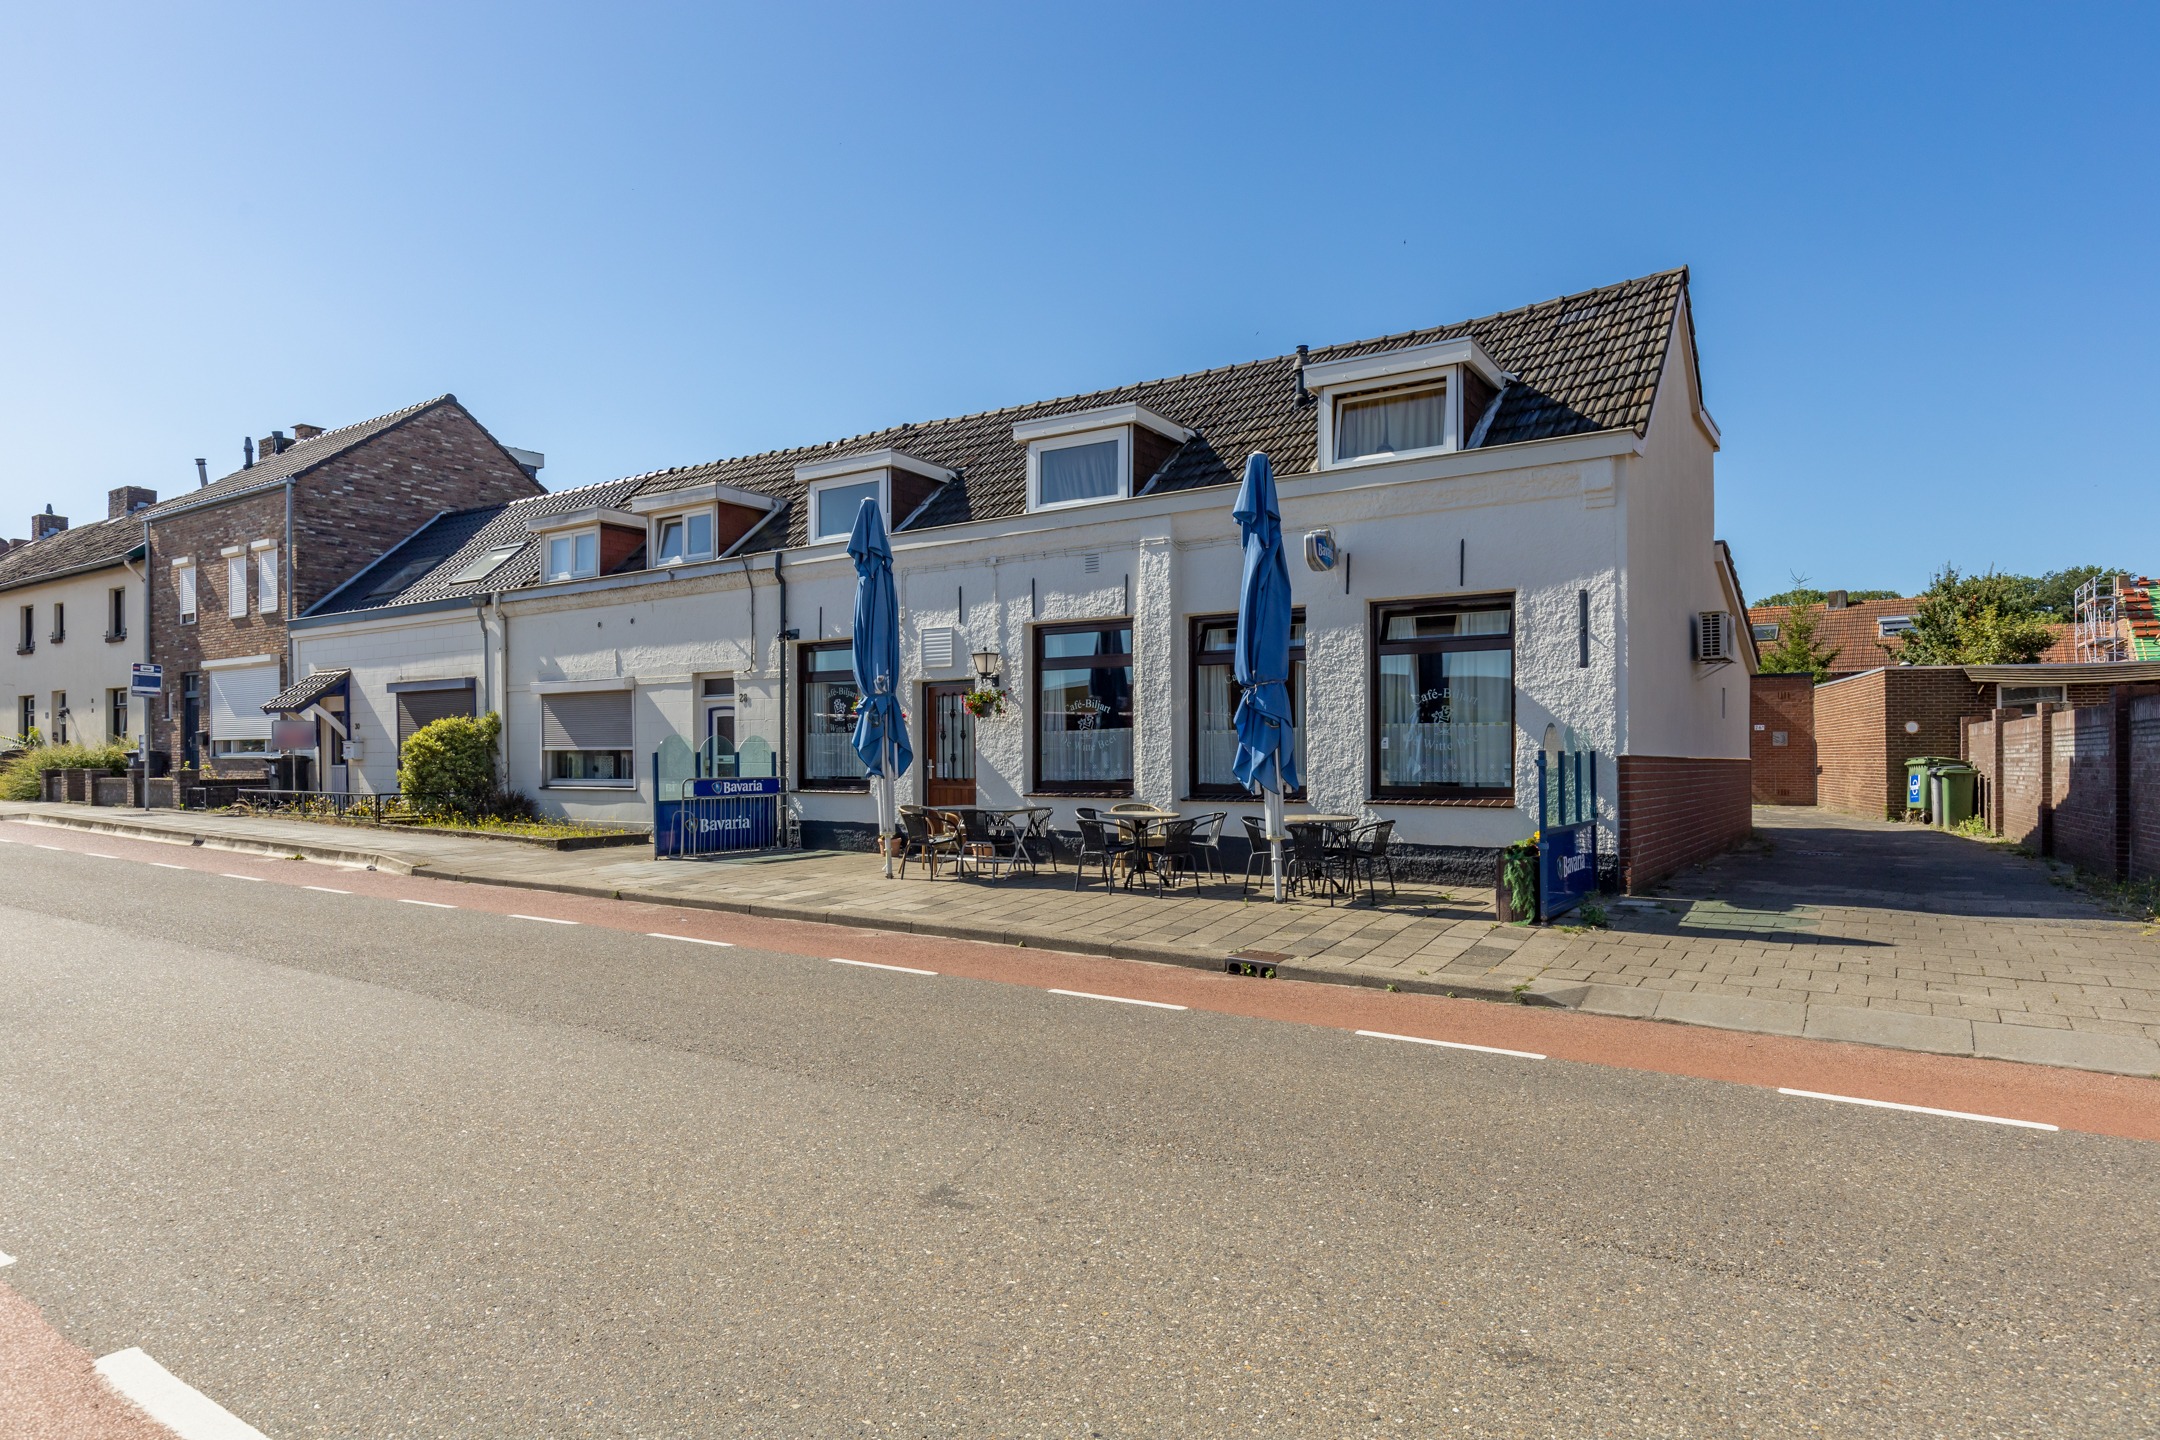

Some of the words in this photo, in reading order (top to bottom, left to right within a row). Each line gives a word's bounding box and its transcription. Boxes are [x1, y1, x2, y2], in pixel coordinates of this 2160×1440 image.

[739, 693, 748, 703] 28
[1064, 699, 1111, 714] Café-Biljart
[1424, 738, 1453, 751] Witte
[723, 780, 763, 794] Bavaria
[700, 815, 750, 833] Bavaria
[1563, 854, 1586, 878] Bavaria
